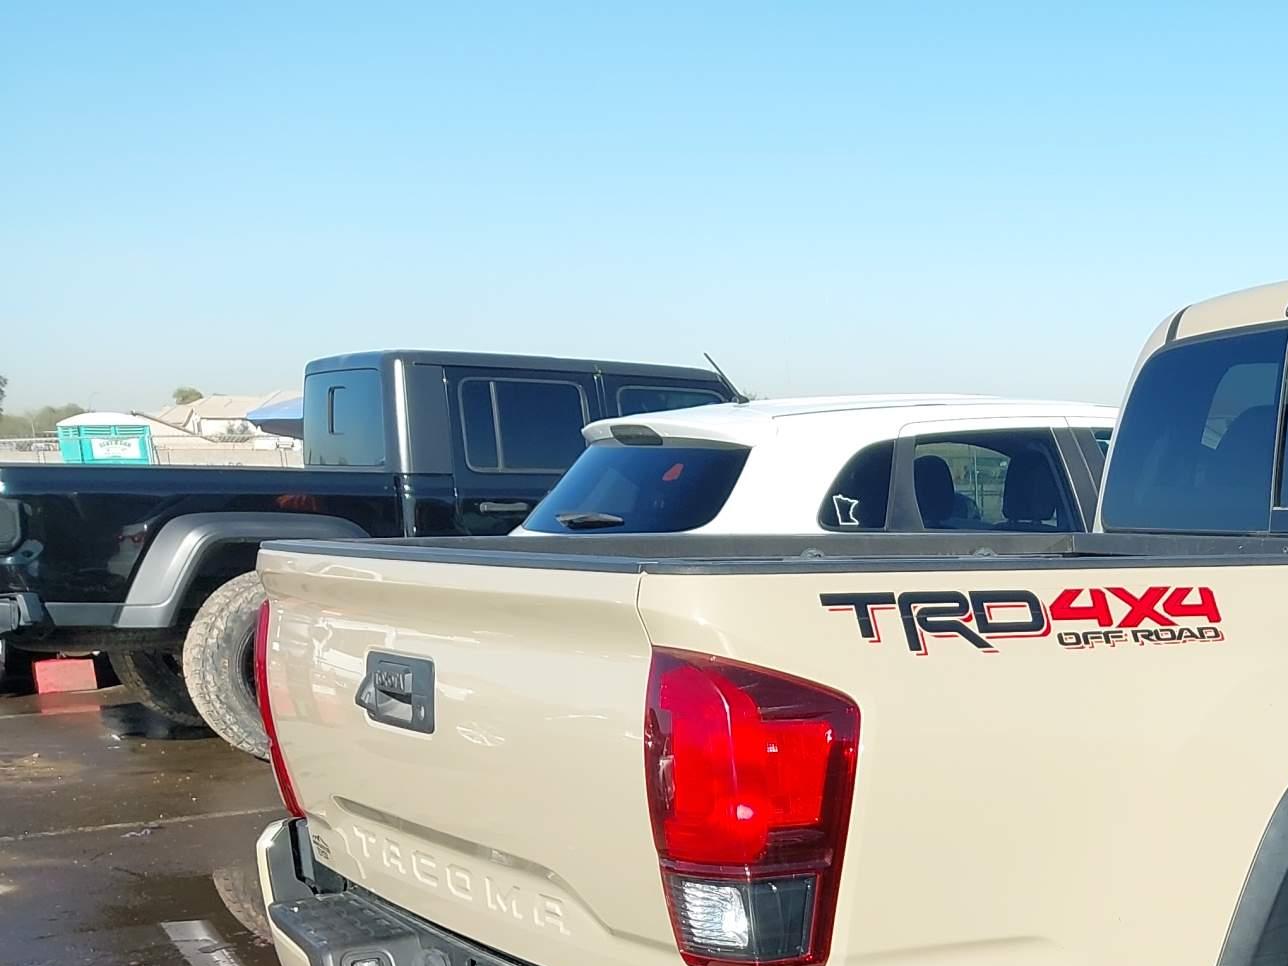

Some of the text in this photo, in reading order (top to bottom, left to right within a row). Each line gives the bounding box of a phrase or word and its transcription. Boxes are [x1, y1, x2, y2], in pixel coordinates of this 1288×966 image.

[819, 586, 1222, 656] TRD 4X4
[1056, 626, 1225, 649] OFF ROAD
[351, 824, 572, 936] TACOMA
